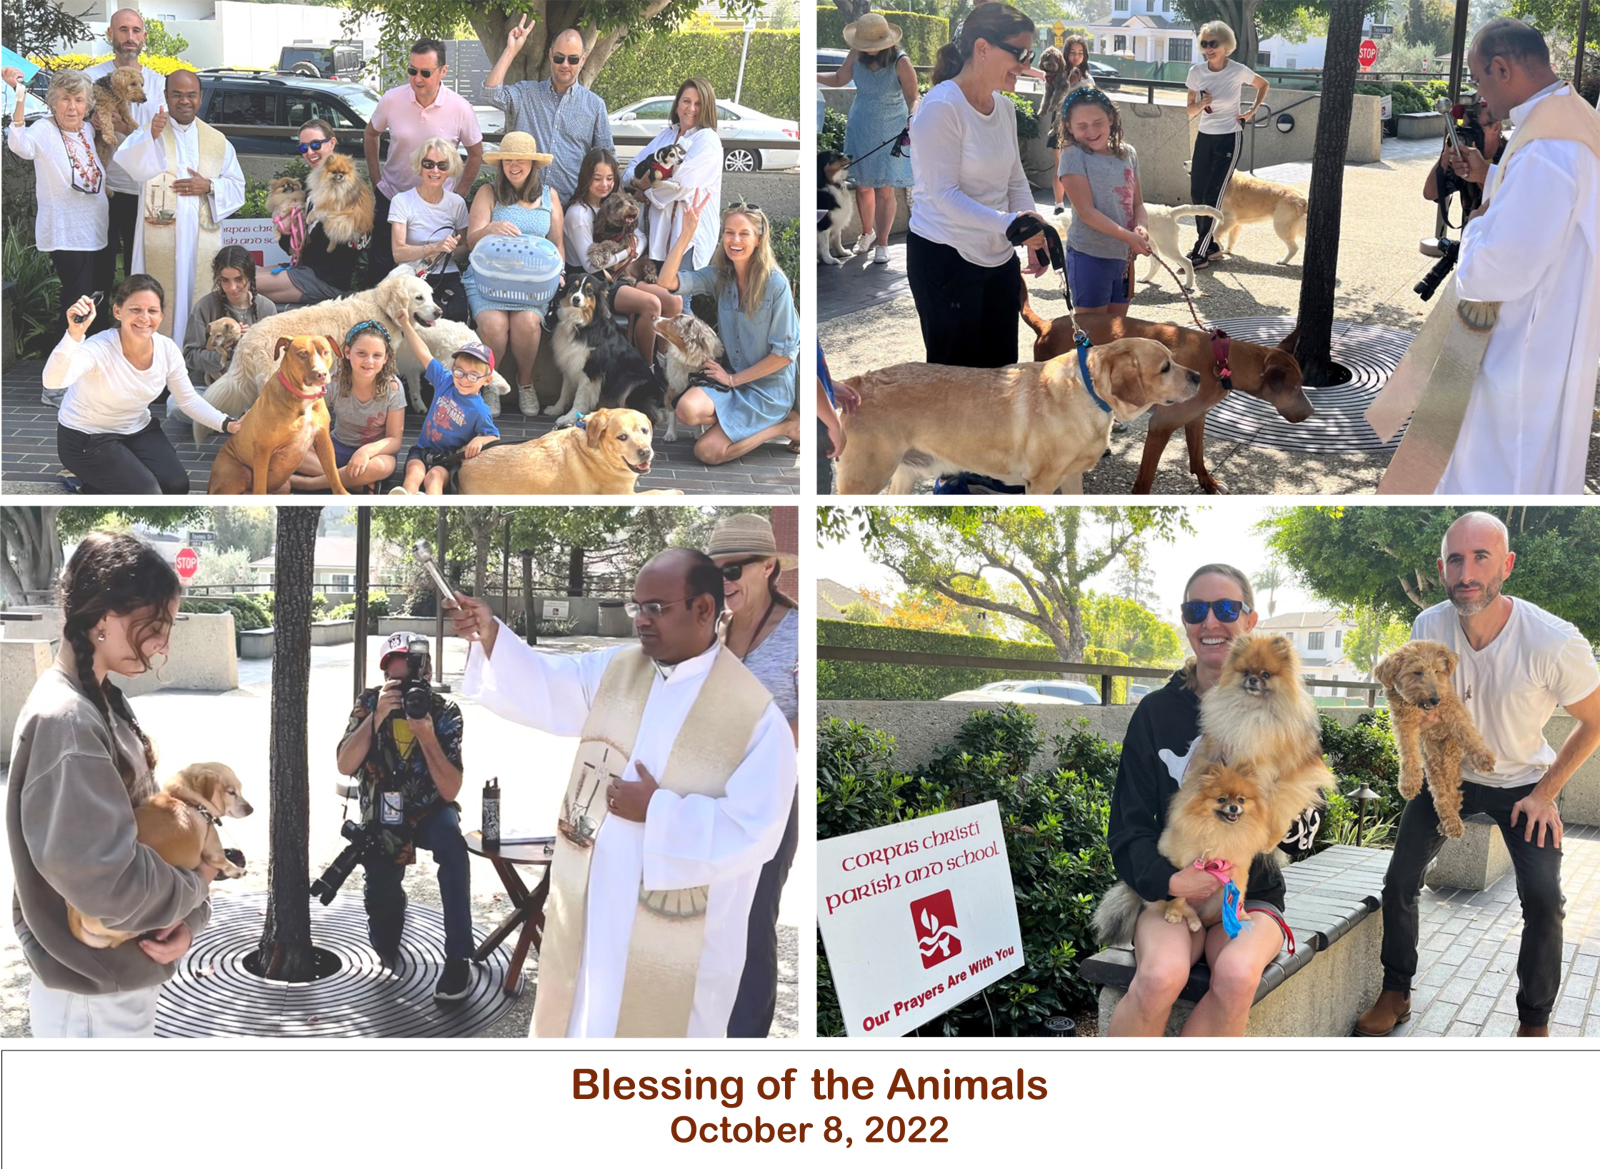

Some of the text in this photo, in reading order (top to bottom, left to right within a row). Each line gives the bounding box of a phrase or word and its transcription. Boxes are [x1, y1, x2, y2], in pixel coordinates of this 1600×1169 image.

[1359, 48, 1376, 59] STOP
[177, 557, 197, 570] STOP
[862, 945, 1015, 1032] Our Prayers Are With You
